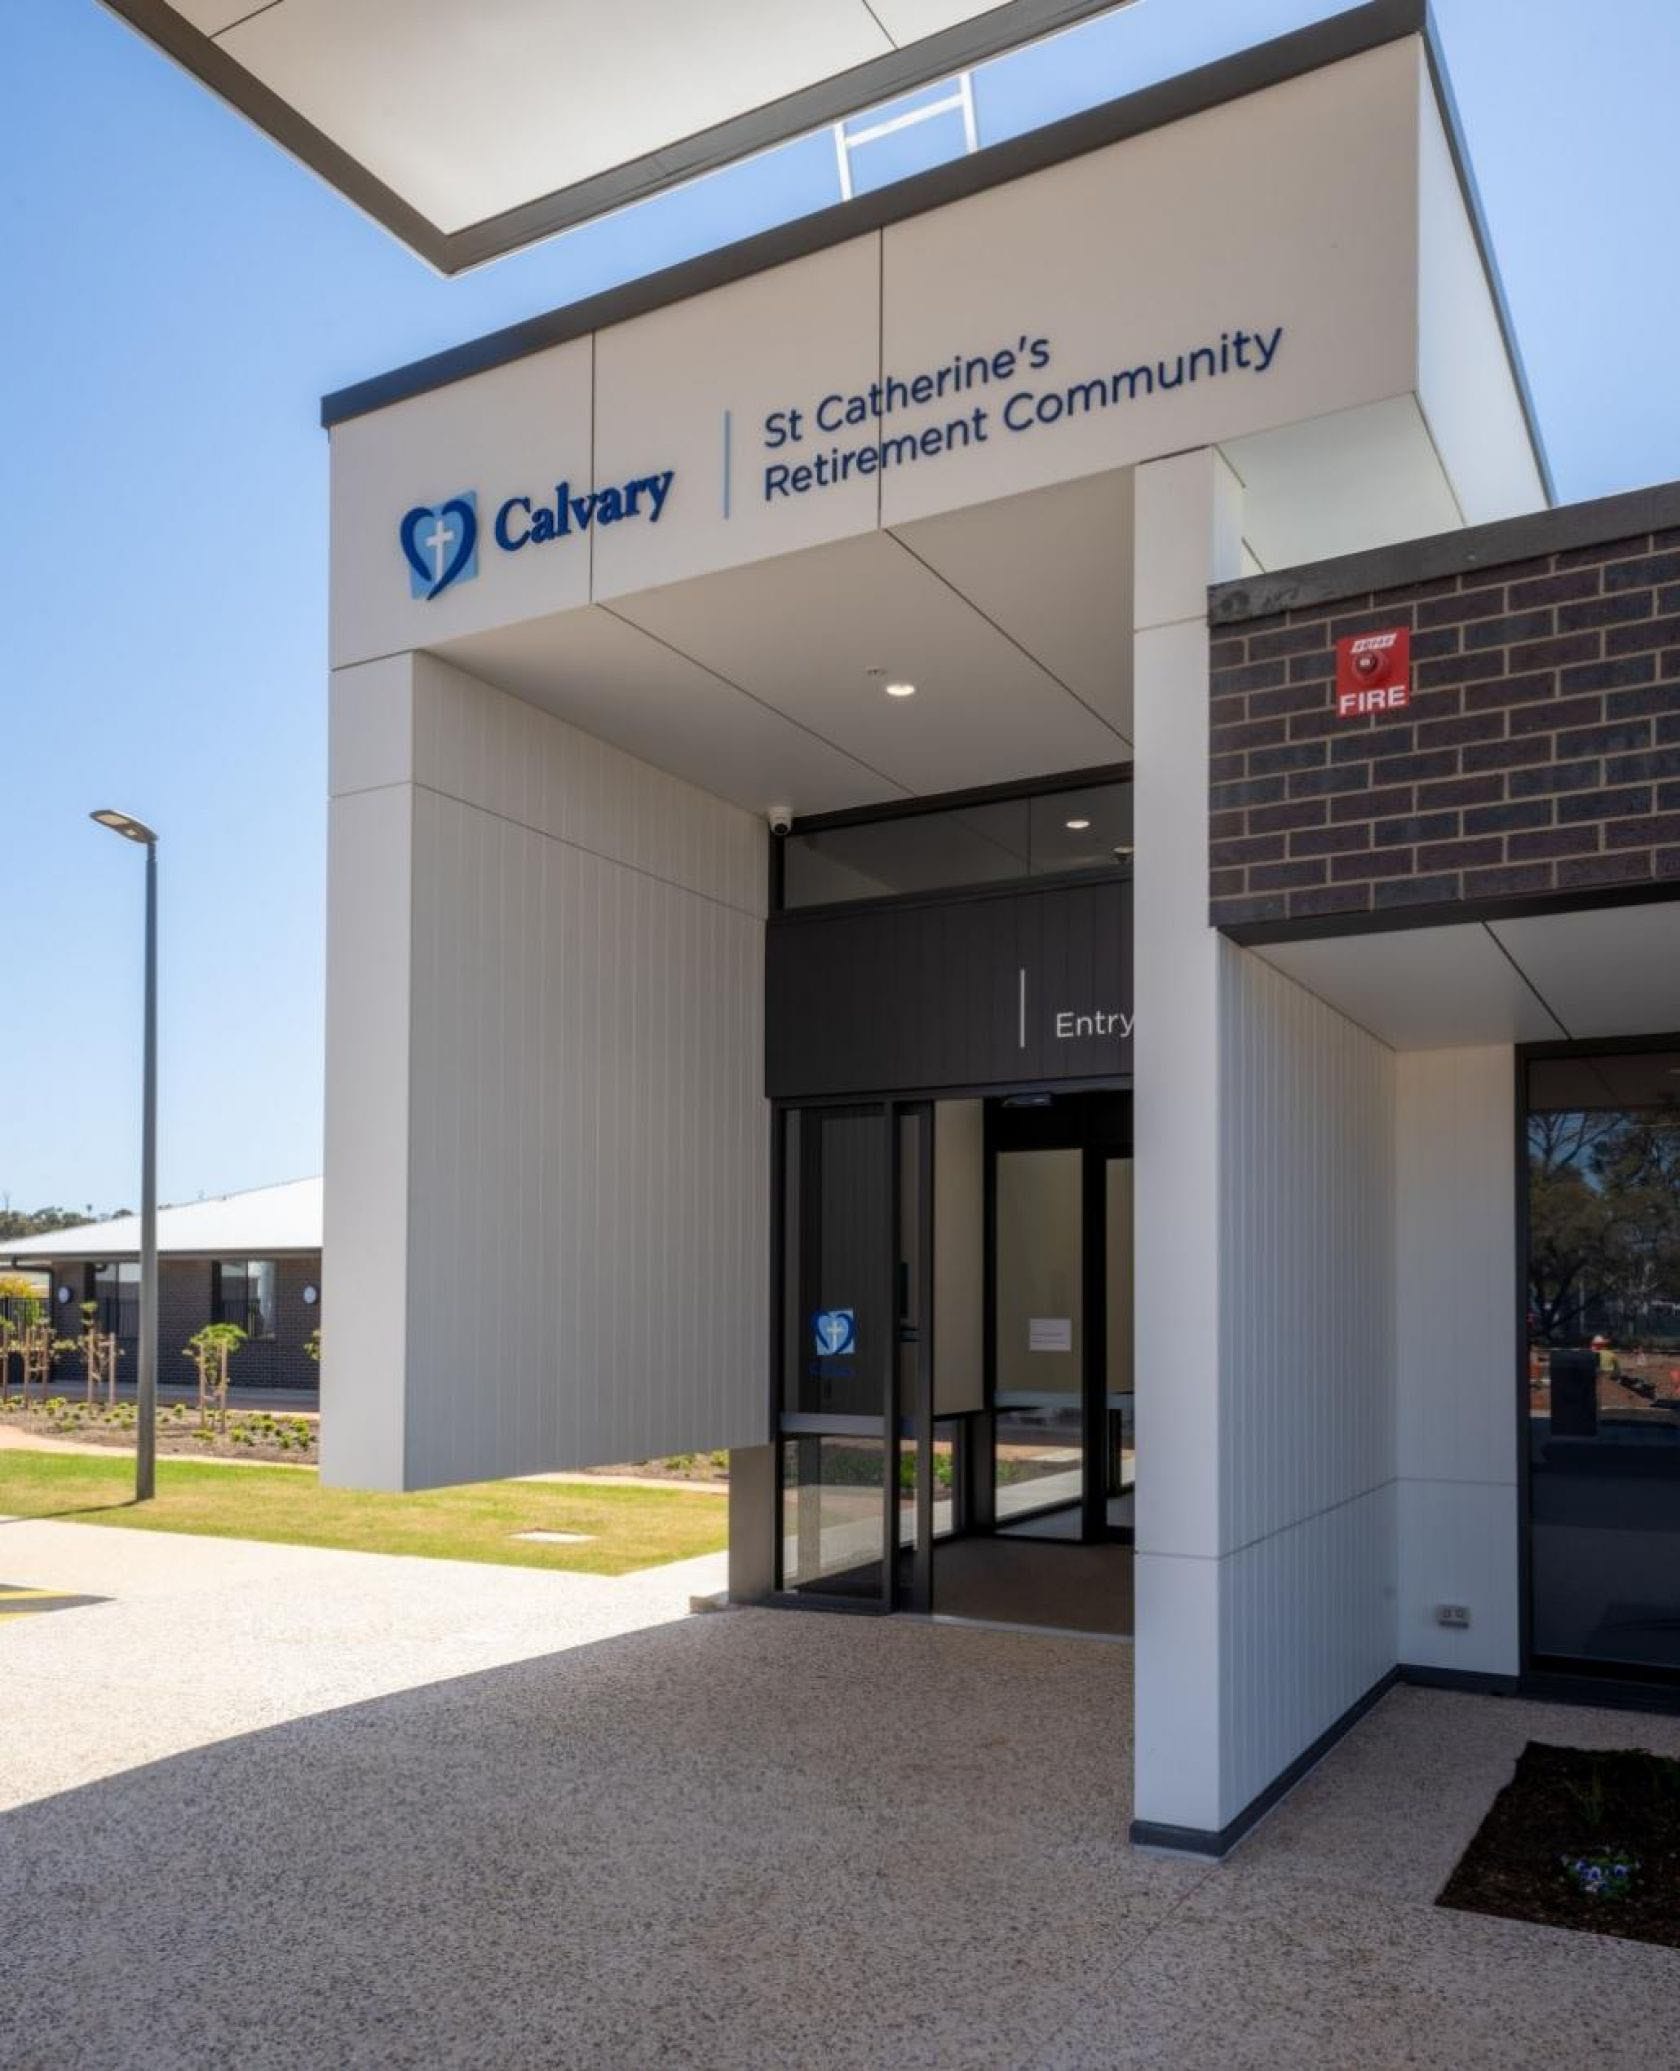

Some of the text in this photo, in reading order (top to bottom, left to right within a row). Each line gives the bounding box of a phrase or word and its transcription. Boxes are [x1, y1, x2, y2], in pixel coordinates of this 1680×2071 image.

[765, 328, 1283, 501] Retirement Community
[766, 335, 1050, 449] St Catherine's
[495, 470, 675, 552] Calvary
[1339, 685, 1407, 716] FIRE
[1056, 1010, 1135, 1038] Entry
